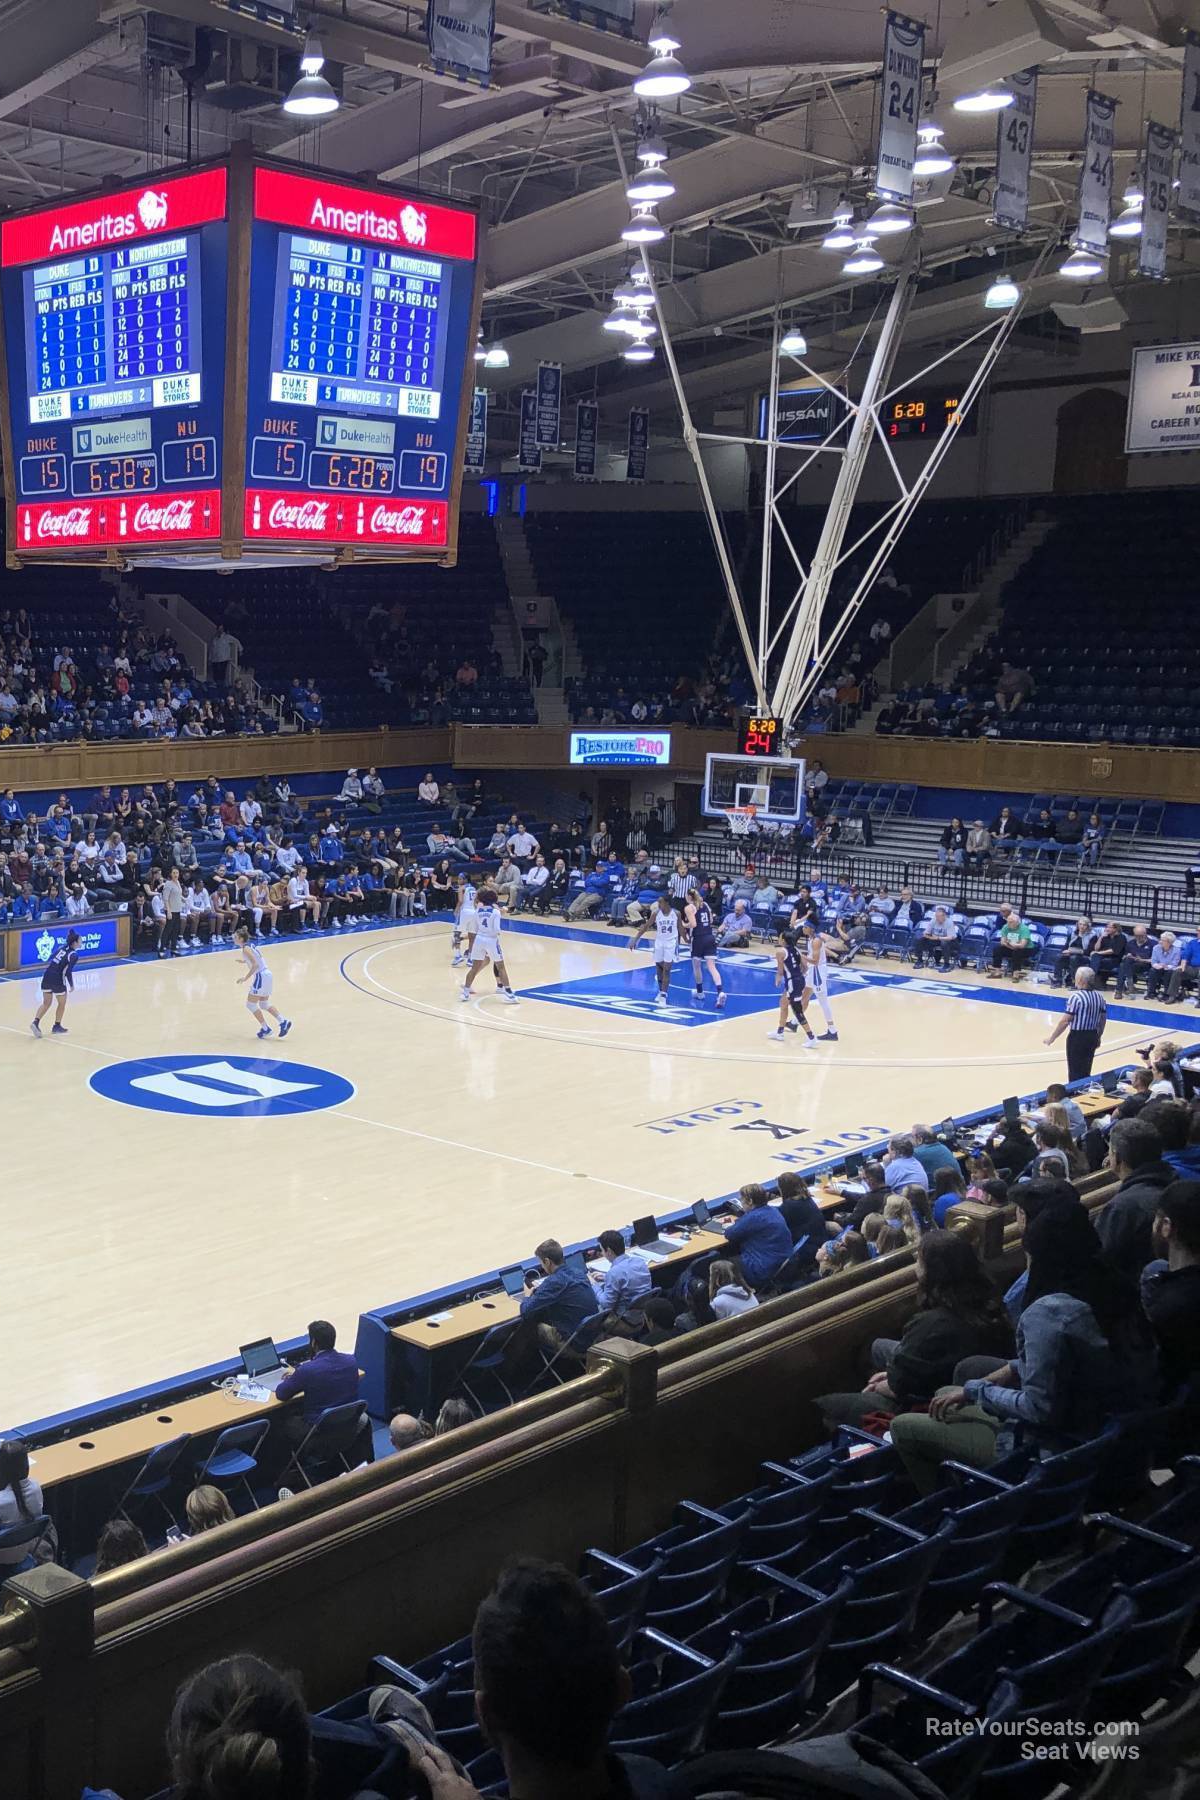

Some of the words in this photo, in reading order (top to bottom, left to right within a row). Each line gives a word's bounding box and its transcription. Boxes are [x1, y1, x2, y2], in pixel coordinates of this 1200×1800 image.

[889, 81, 914, 124] 24
[1007, 118, 1028, 154] 43
[1090, 153, 1110, 187] 44
[1150, 180, 1167, 212] 25
[310, 198, 399, 240] Ameritas
[49, 212, 136, 251] Ameritas
[130, 239, 186, 263] NORTHWESTERN
[309, 241, 331, 256] DUKE
[50, 266, 70, 278] DUKE
[390, 255, 441, 278] NORTHWESTERN
[116, 286, 127, 298] NO
[132, 282, 147, 296] PTS
[150, 278, 166, 292] REB
[170, 274, 185, 288] FLS
[293, 273, 304, 287] NO
[309, 275, 325, 290] PTS
[328, 278, 343, 293] REB
[346, 280, 361, 296] FLS
[38, 302, 49, 314] NO
[53, 297, 68, 310] PTS
[70, 294, 85, 308] REB
[88, 291, 102, 304] FLS
[374, 287, 386, 300] NO
[390, 289, 404, 303] PTS
[406, 292, 421, 306] REB
[424, 295, 437, 308] FLS
[43, 317, 46, 328] 3
[59, 314, 63, 325] 3
[76, 311, 80, 321] 4
[94, 308, 96, 318] 1
[42, 332, 47, 342] 4
[60, 329, 64, 340] 0
[76, 326, 80, 337] 2
[94, 324, 97, 334] 1
[44, 347, 48, 358] 5
[60, 344, 64, 356] 2
[78, 342, 80, 352] 1
[94, 338, 98, 350] 0
[42, 362, 50, 373] 15
[60, 360, 64, 370] 0
[77, 357, 82, 368] 0
[94, 354, 98, 365] 0
[1155, 352, 1182, 364] MIKE
[42, 377, 51, 388] 24
[61, 375, 65, 386] 0
[78, 372, 82, 384] 0
[96, 370, 98, 380] 1
[162, 378, 190, 390] DUKE
[282, 378, 308, 389] DUKE
[90, 392, 133, 407] TURNOVERS
[140, 389, 145, 399] 2
[163, 392, 190, 403] STORES
[282, 392, 307, 402] STORES
[325, 386, 331, 399] 5
[338, 388, 381, 405] TURNOVERS
[386, 394, 392, 405] 2
[408, 392, 432, 402] DUKE
[38, 397, 62, 407] DUKE
[78, 398, 84, 408] 5
[408, 406, 430, 414] STORES
[894, 402, 925, 419] 6:28
[38, 408, 62, 419] STORES
[775, 408, 828, 422] NISSAN
[177, 420, 197, 436] NU
[264, 418, 298, 436] DUKE
[890, 424, 898, 436] 3
[921, 422, 926, 433] 1
[1150, 418, 1190, 429] CAREER
[28, 437, 58, 452] DUKE
[96, 430, 148, 446] DukeHealth
[340, 428, 391, 444] DukeHealth
[416, 432, 433, 448] NU
[136, 459, 155, 469] PERIOD
[186, 444, 206, 473] 19
[276, 444, 295, 475] 15
[376, 462, 394, 472] PERIOD
[42, 459, 58, 488] 15
[90, 458, 135, 491] 6:28
[143, 468, 150, 485] 2
[328, 454, 375, 488] 6:28
[420, 456, 438, 484] 19
[380, 471, 388, 488] 2
[38, 507, 93, 538] Coca-Cola
[134, 500, 195, 531] Coca-Cola
[269, 499, 329, 530] Coca-Cola
[370, 505, 426, 534] Coca-Cola
[749, 720, 776, 733] 6:28
[744, 732, 770, 754] 24
[482, 918, 488, 928] 4
[700, 912, 710, 922] 21
[661, 926, 673, 934] 24
[646, 1100, 764, 1134] COURT
[730, 1119, 810, 1140] K
[770, 1126, 891, 1164] COACH
